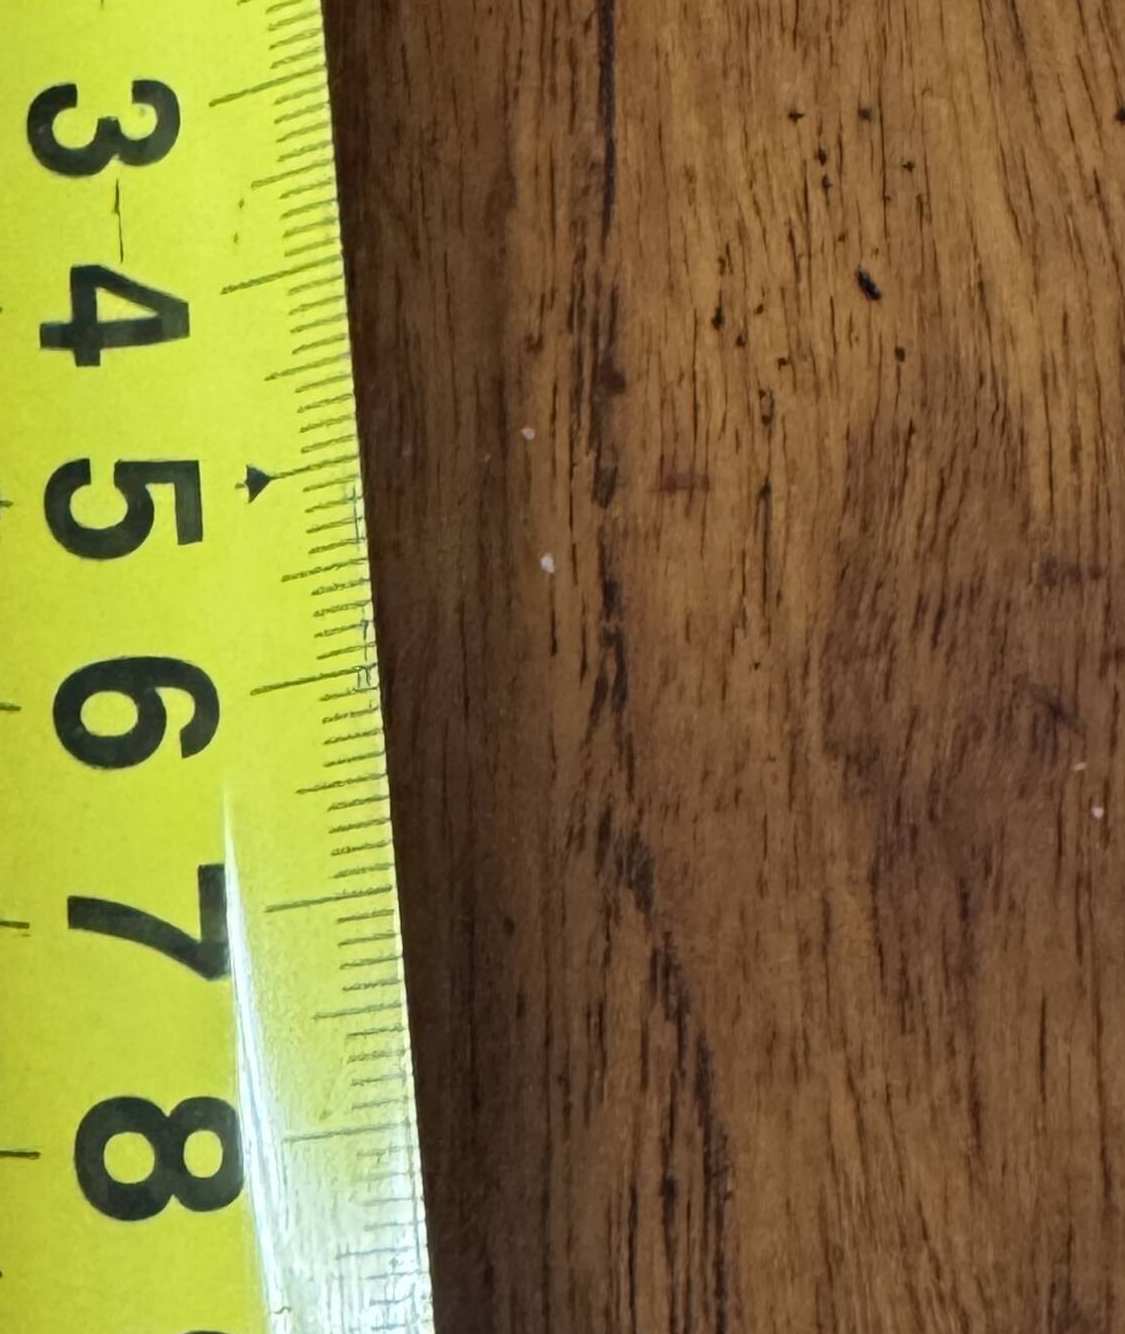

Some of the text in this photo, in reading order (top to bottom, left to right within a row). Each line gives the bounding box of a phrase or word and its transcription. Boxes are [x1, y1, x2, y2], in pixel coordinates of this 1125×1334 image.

[26, 78, 181, 178] 3
[38, 264, 190, 368] 4
[43, 457, 204, 560] 5
[52, 655, 220, 770] 6
[66, 863, 229, 982] 7
[73, 1095, 246, 1222] 8
